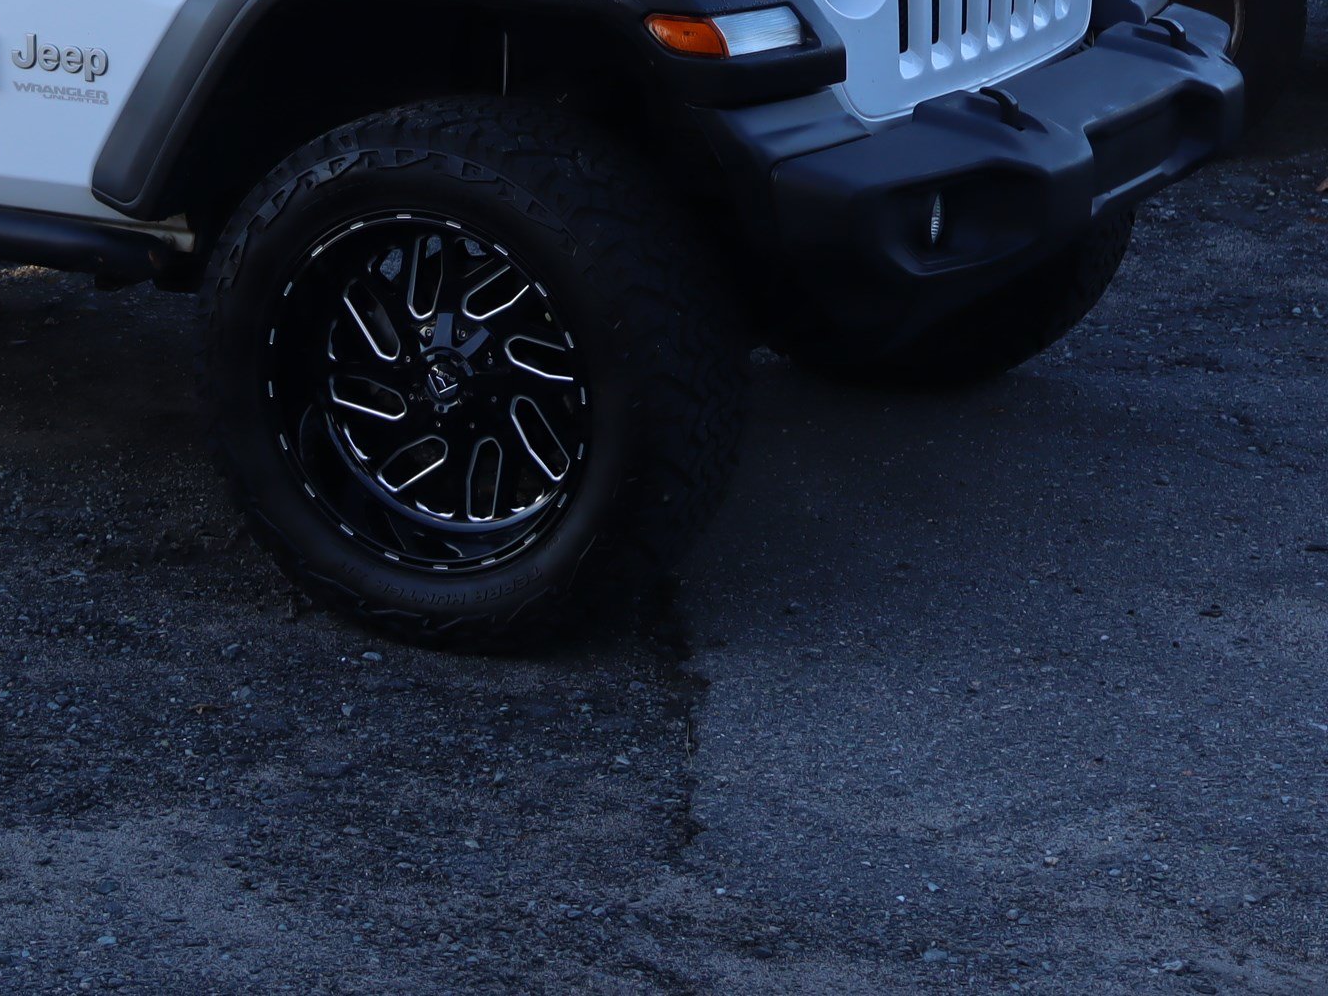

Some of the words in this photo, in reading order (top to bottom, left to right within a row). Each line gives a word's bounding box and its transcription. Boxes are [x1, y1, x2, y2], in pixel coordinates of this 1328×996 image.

[12, 33, 109, 82] Jeep
[13, 81, 108, 101] WRANGLER
[43, 94, 109, 105] UNLIMITED
